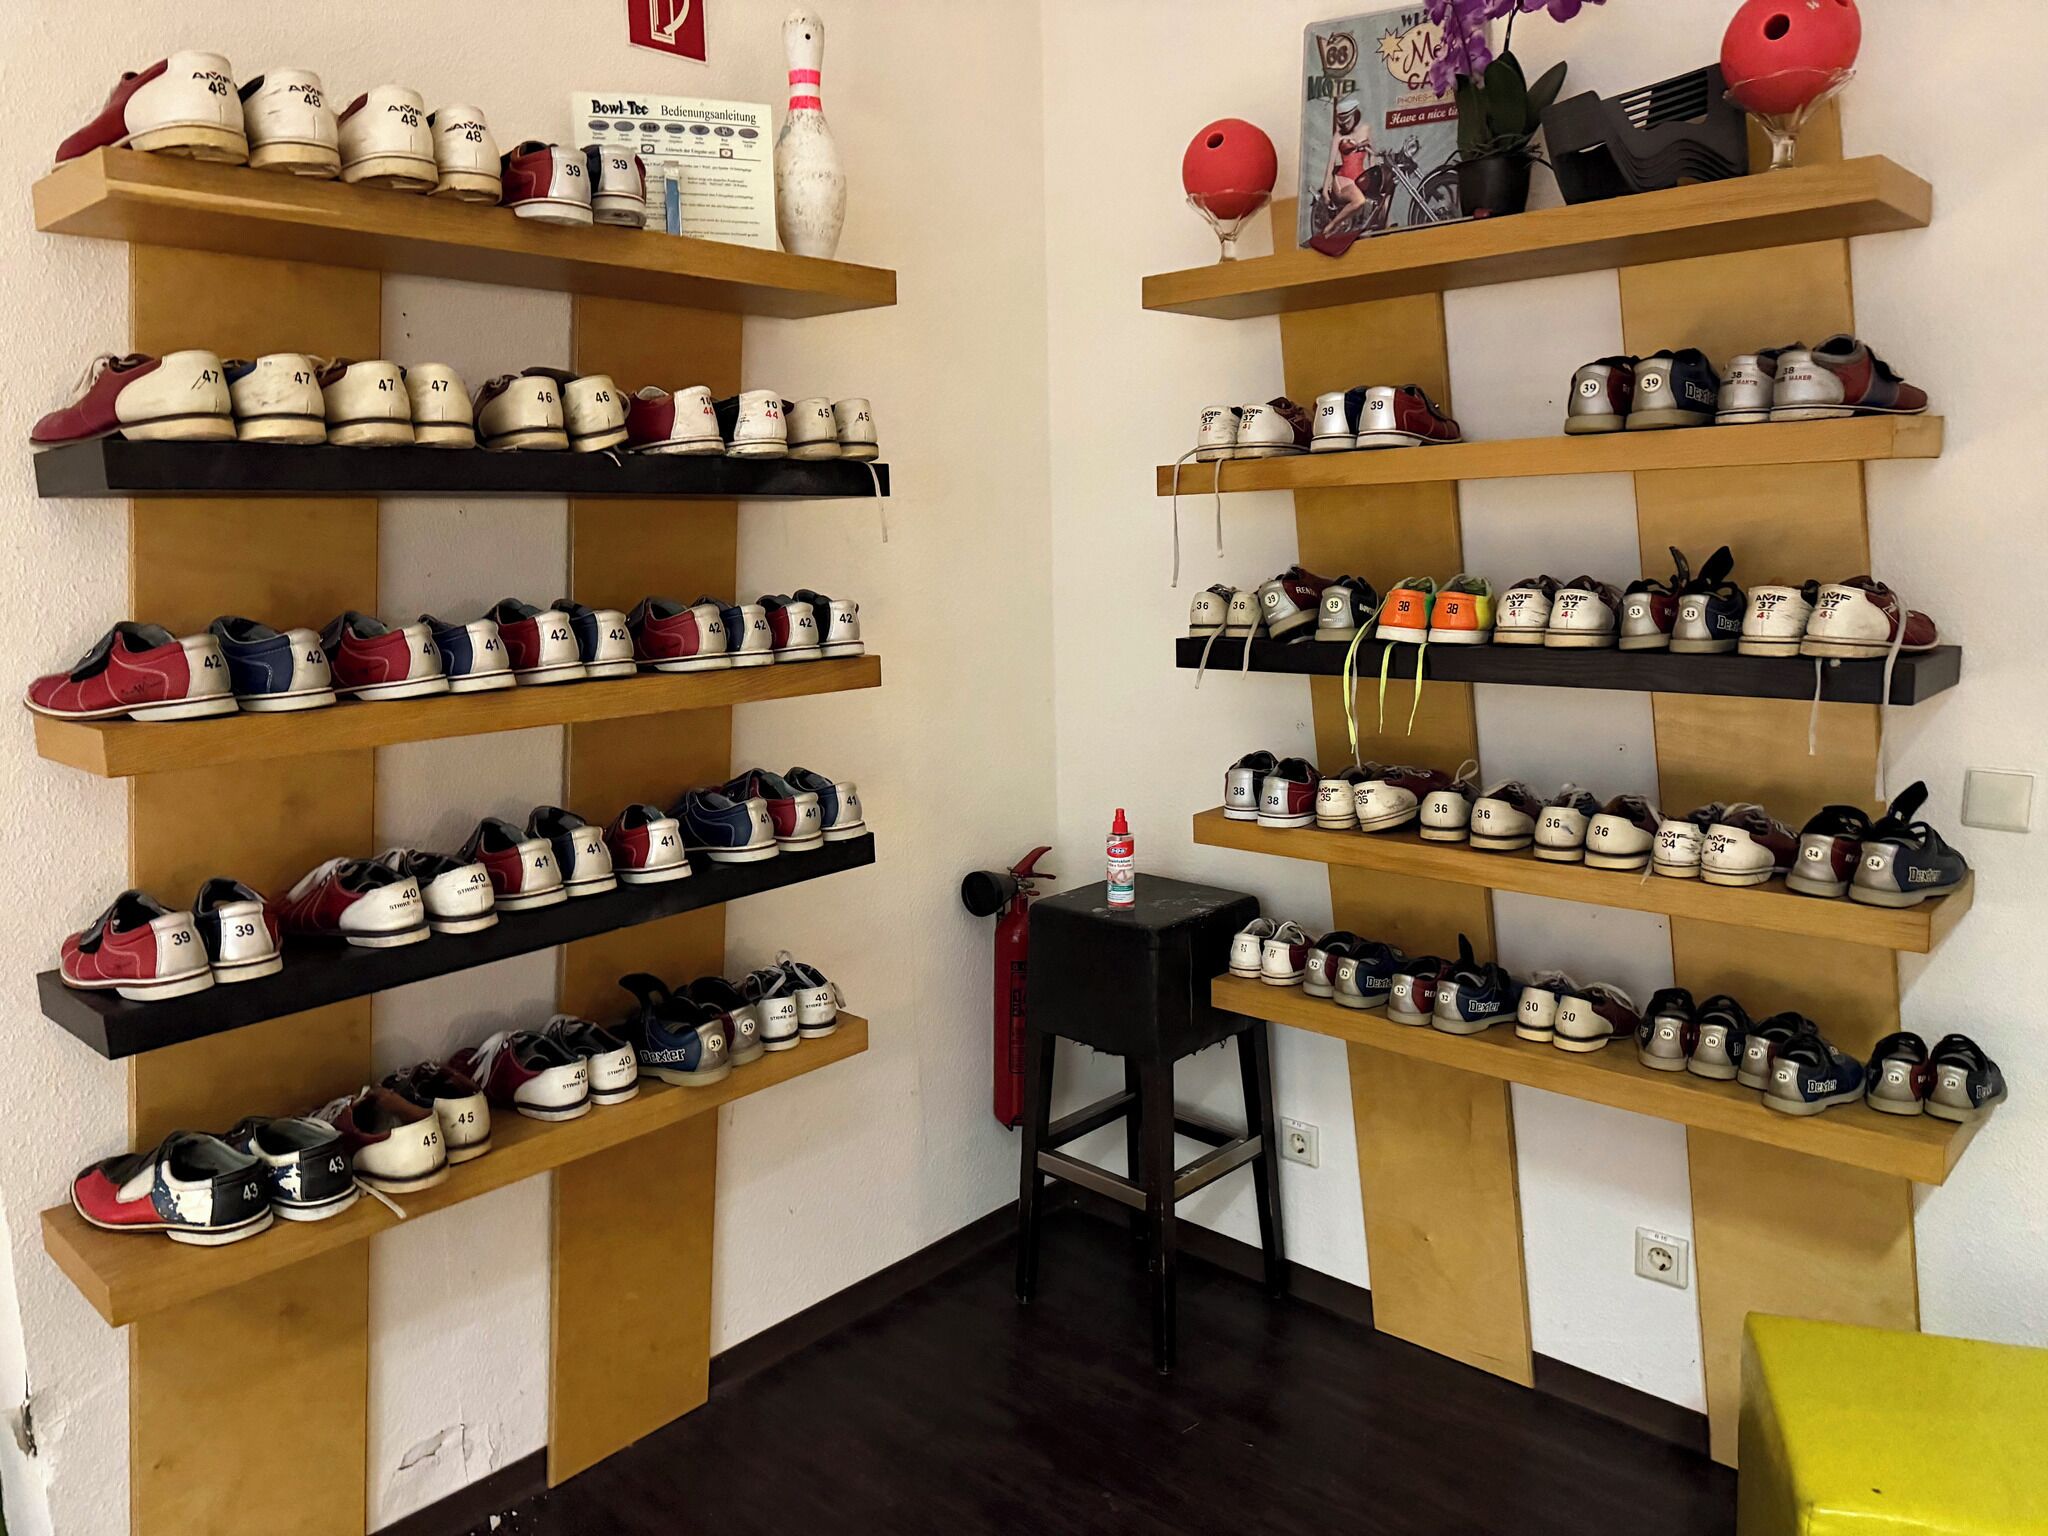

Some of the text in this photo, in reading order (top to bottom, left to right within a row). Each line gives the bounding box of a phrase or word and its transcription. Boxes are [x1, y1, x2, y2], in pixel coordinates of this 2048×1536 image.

[1326, 46, 1348, 65] 66
[208, 82, 227, 96] 48
[1308, 76, 1356, 100] MOTEL
[304, 94, 321, 108] 48
[592, 100, 756, 124] Bowl-Tec Bedienungsanleitung
[1390, 111, 1416, 124] Have
[1428, 108, 1447, 119] nice
[401, 114, 418, 127] 48
[466, 131, 482, 142] 48
[612, 159, 627, 170] 39
[565, 164, 581, 178] 39
[202, 370, 219, 383] 47
[294, 372, 310, 385] 47
[378, 379, 394, 391] 47
[431, 381, 448, 392] 47
[1582, 383, 1597, 393] 39
[1643, 377, 1658, 389] 39
[537, 391, 552, 403] 46
[596, 391, 610, 403] 46
[765, 400, 777, 409] 10
[1370, 400, 1384, 411] 39
[704, 407, 713, 415] 44
[766, 410, 778, 419] 44
[817, 408, 830, 418] 45
[858, 412, 869, 421] 45
[1322, 406, 1334, 416] 39
[1506, 593, 1533, 601] AMF
[1755, 593, 1788, 602] AMF
[1821, 592, 1852, 600] AMF
[1196, 602, 1209, 610] 36
[1233, 601, 1245, 610] 36
[1398, 601, 1410, 612] 38
[1446, 603, 1459, 614] 38
[1821, 600, 1840, 608] 37
[800, 618, 812, 628] 42
[839, 613, 853, 624] 42
[709, 622, 722, 634] 42
[754, 620, 766, 630] 42
[551, 629, 568, 640] 42
[610, 629, 626, 640] 42
[485, 638, 500, 651] 41
[204, 655, 222, 669] 42
[306, 651, 323, 664] 42
[1233, 787, 1245, 796] 38
[1320, 793, 1331, 801] 35
[846, 795, 857, 806] 41
[1267, 796, 1279, 805] 38
[1358, 795, 1368, 804] 35
[806, 807, 817, 818] 41
[1434, 804, 1448, 814] 36
[760, 813, 770, 824] 41
[1477, 810, 1491, 820] 36
[1546, 818, 1561, 829] 36
[1594, 825, 1609, 837] 36
[1657, 831, 1688, 839] AMF
[661, 835, 675, 847] 41
[1662, 838, 1676, 849] 34
[1707, 834, 1737, 844] AMF
[587, 842, 601, 855] 41
[1710, 842, 1725, 854] 34
[1807, 849, 1820, 858] 34
[534, 855, 550, 869] 41
[1869, 859, 1881, 867] 34
[470, 872, 486, 883] 40
[402, 888, 417, 899] 40
[235, 924, 254, 937] 39
[172, 931, 191, 946] 39
[815, 993, 828, 1001] 40
[781, 1005, 793, 1013] 40
[1469, 1000, 1500, 1012] Dexter
[1525, 1001, 1539, 1012] 30
[1561, 1011, 1576, 1022] 30
[743, 1022, 754, 1032] 39
[710, 1038, 721, 1049] 39
[619, 1056, 631, 1066] 40
[640, 1048, 686, 1063] Dexter
[574, 1069, 585, 1079] 40
[1807, 1079, 1837, 1094] Dexter
[458, 1111, 475, 1124] 45
[423, 1132, 438, 1148] 45
[328, 1156, 345, 1174] 43
[242, 1183, 259, 1201] 43
